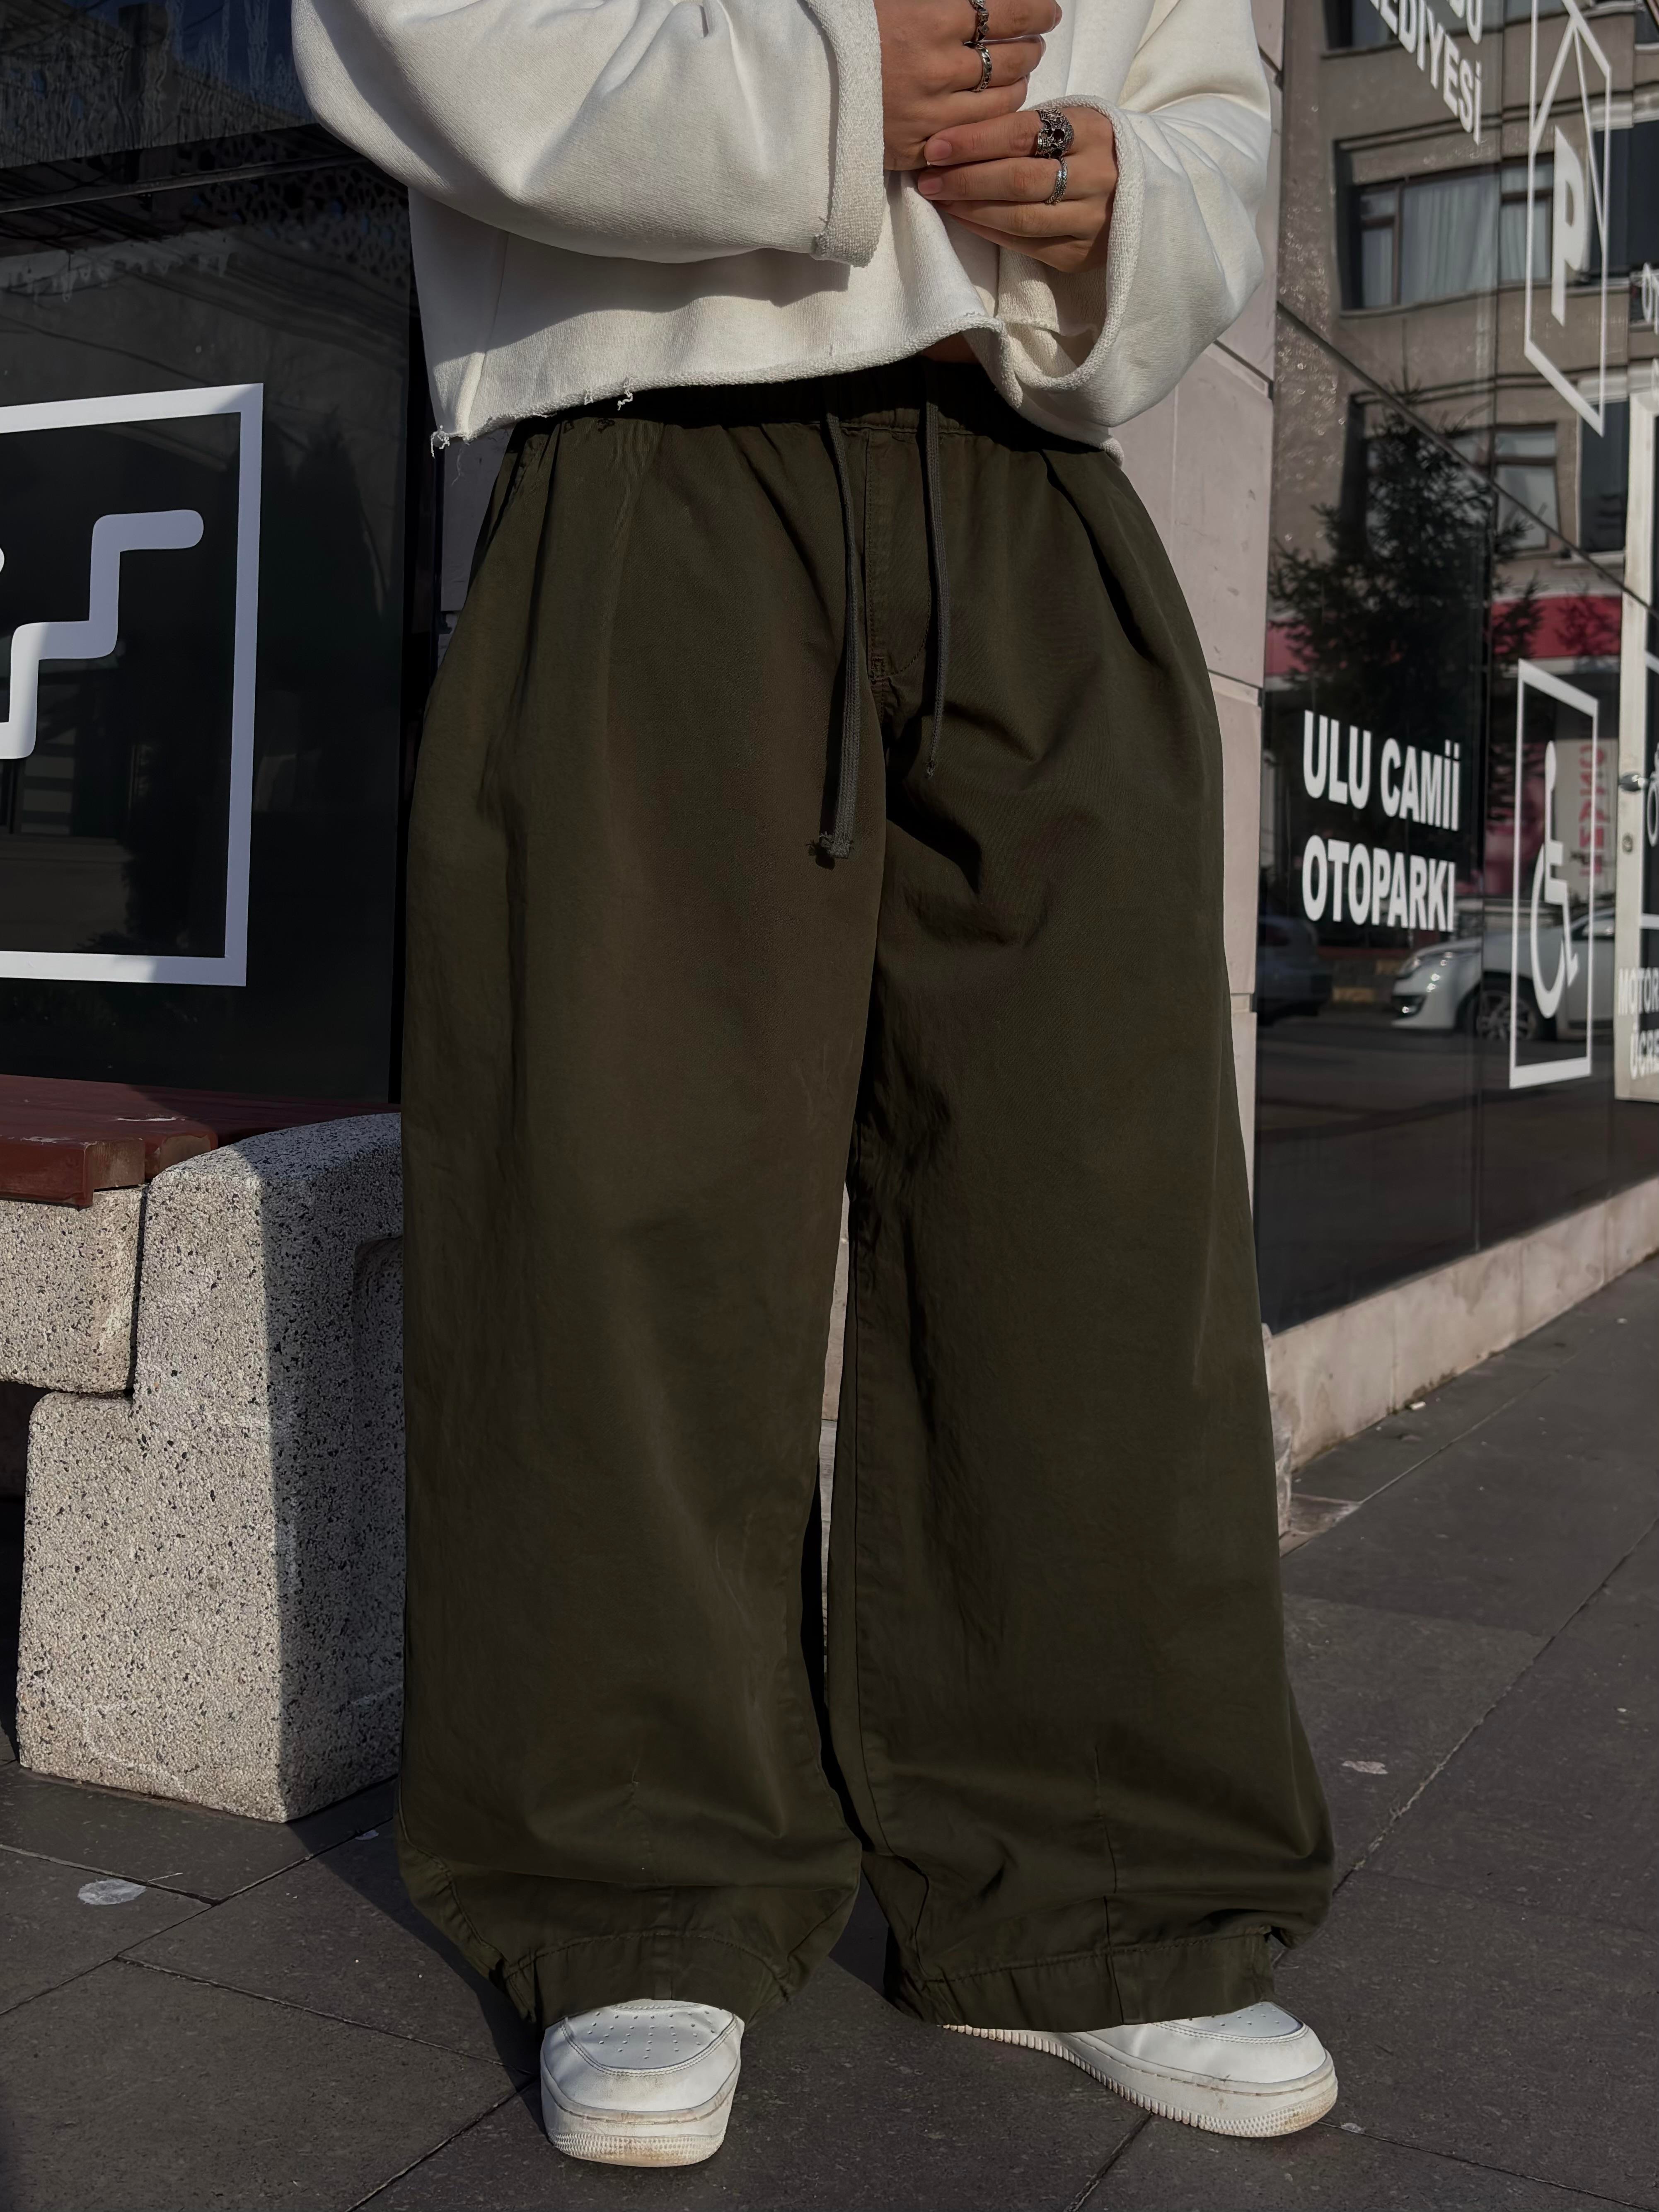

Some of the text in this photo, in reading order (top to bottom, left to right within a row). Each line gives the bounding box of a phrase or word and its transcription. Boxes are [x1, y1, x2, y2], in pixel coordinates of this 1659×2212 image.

[1551, 126, 1589, 327] P
[1304, 711, 1371, 808] ULU
[1302, 834, 1456, 932] OTOPARKI
